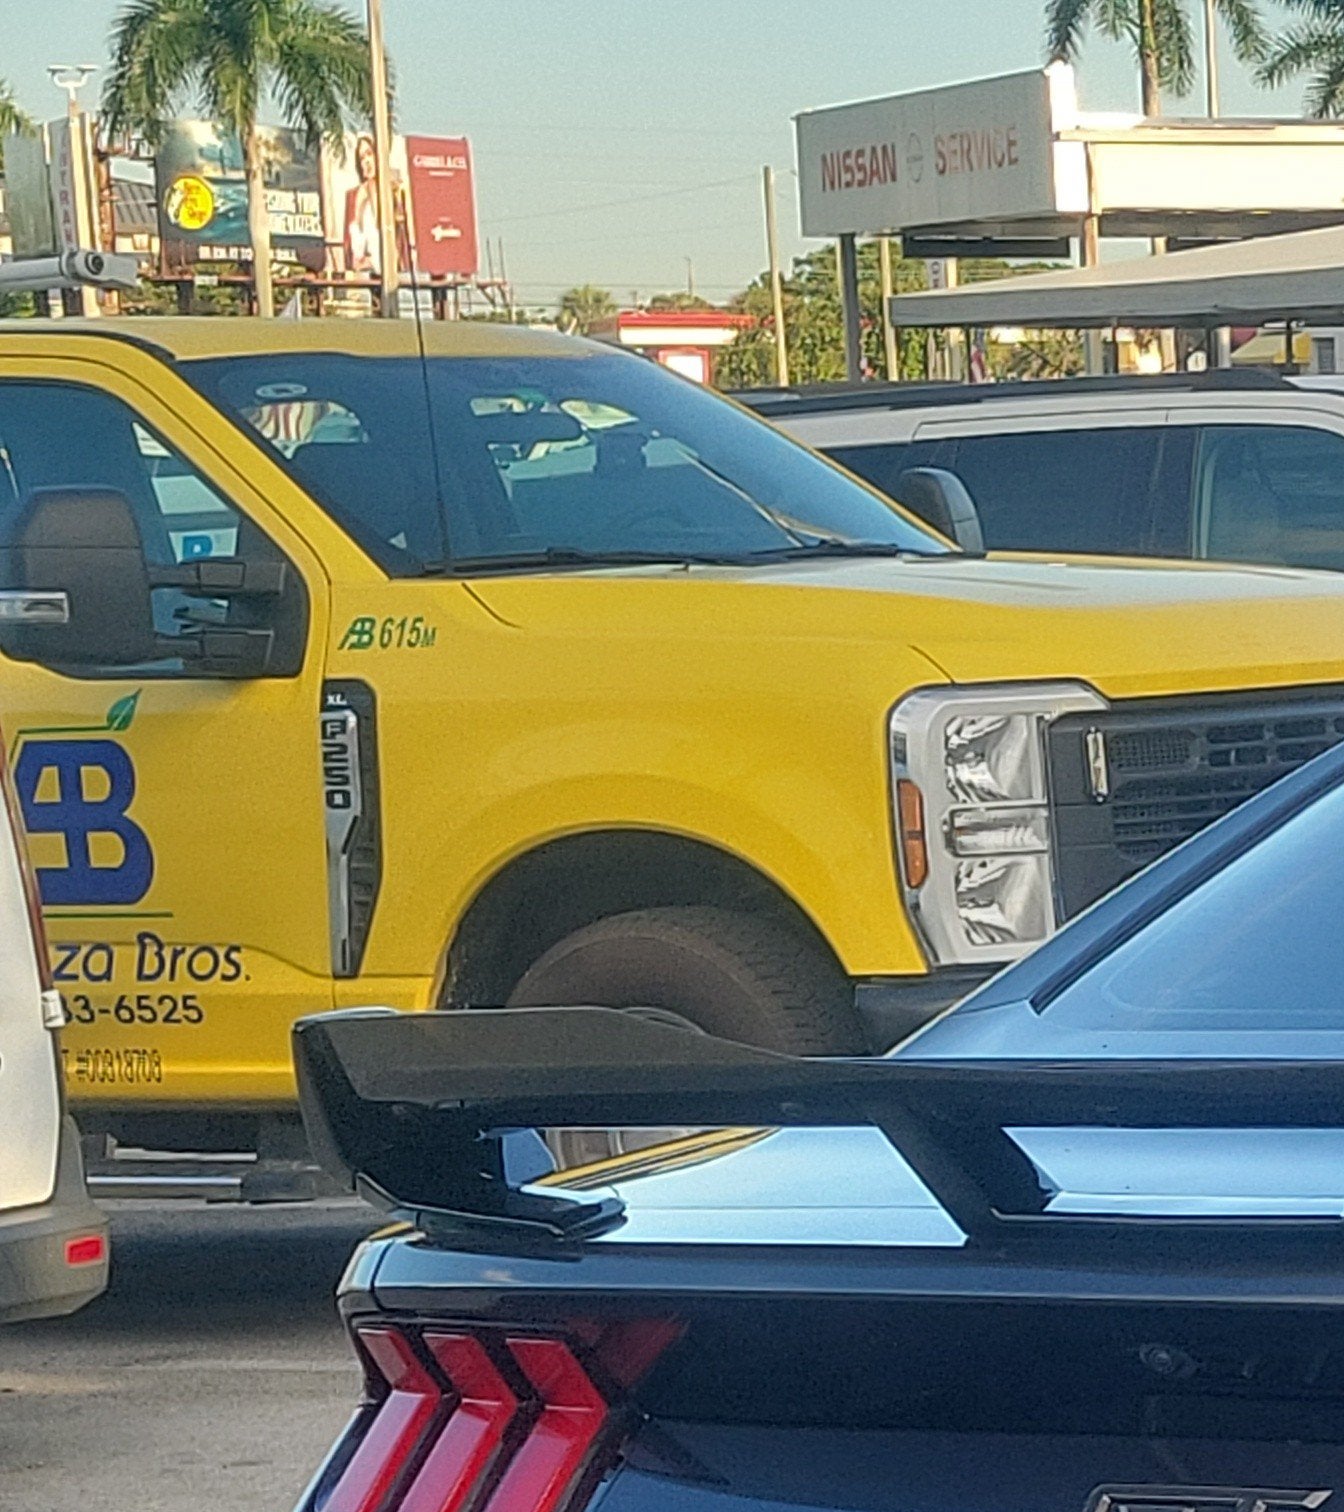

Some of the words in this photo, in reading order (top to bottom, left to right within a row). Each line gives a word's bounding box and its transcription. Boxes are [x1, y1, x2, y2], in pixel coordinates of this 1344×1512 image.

[821, 143, 898, 192] NISSAN
[934, 127, 1019, 176] SERVICE
[326, 694, 347, 706] XL
[136, 931, 251, 982] Bros.
